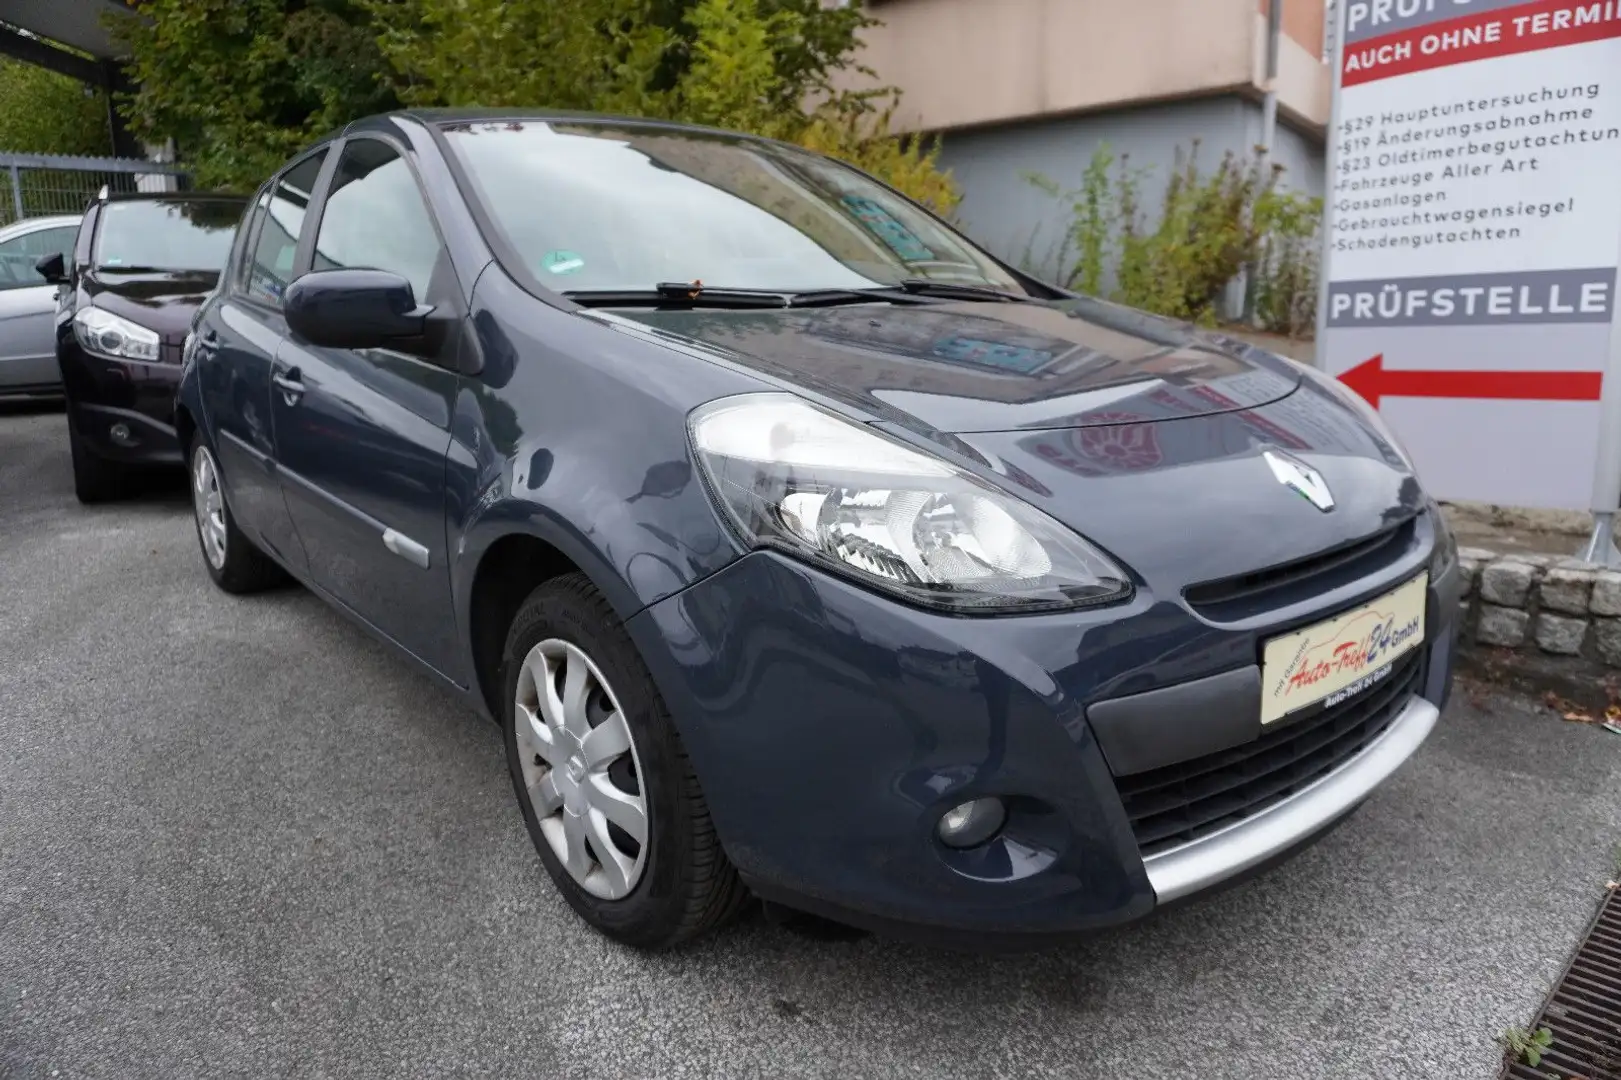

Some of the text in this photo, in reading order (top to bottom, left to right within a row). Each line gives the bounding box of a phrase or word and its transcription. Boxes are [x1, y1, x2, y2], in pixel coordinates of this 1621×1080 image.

[1344, 0, 1621, 73] AUCH OHNE TERMI
[1380, 83, 1600, 125] Hauptuntersuchung
[1376, 107, 1594, 146] Änderungsabnahme
[1442, 162, 1493, 179] Aller
[1501, 157, 1539, 173] Art
[1331, 282, 1609, 320] PRÜFSTELLE
